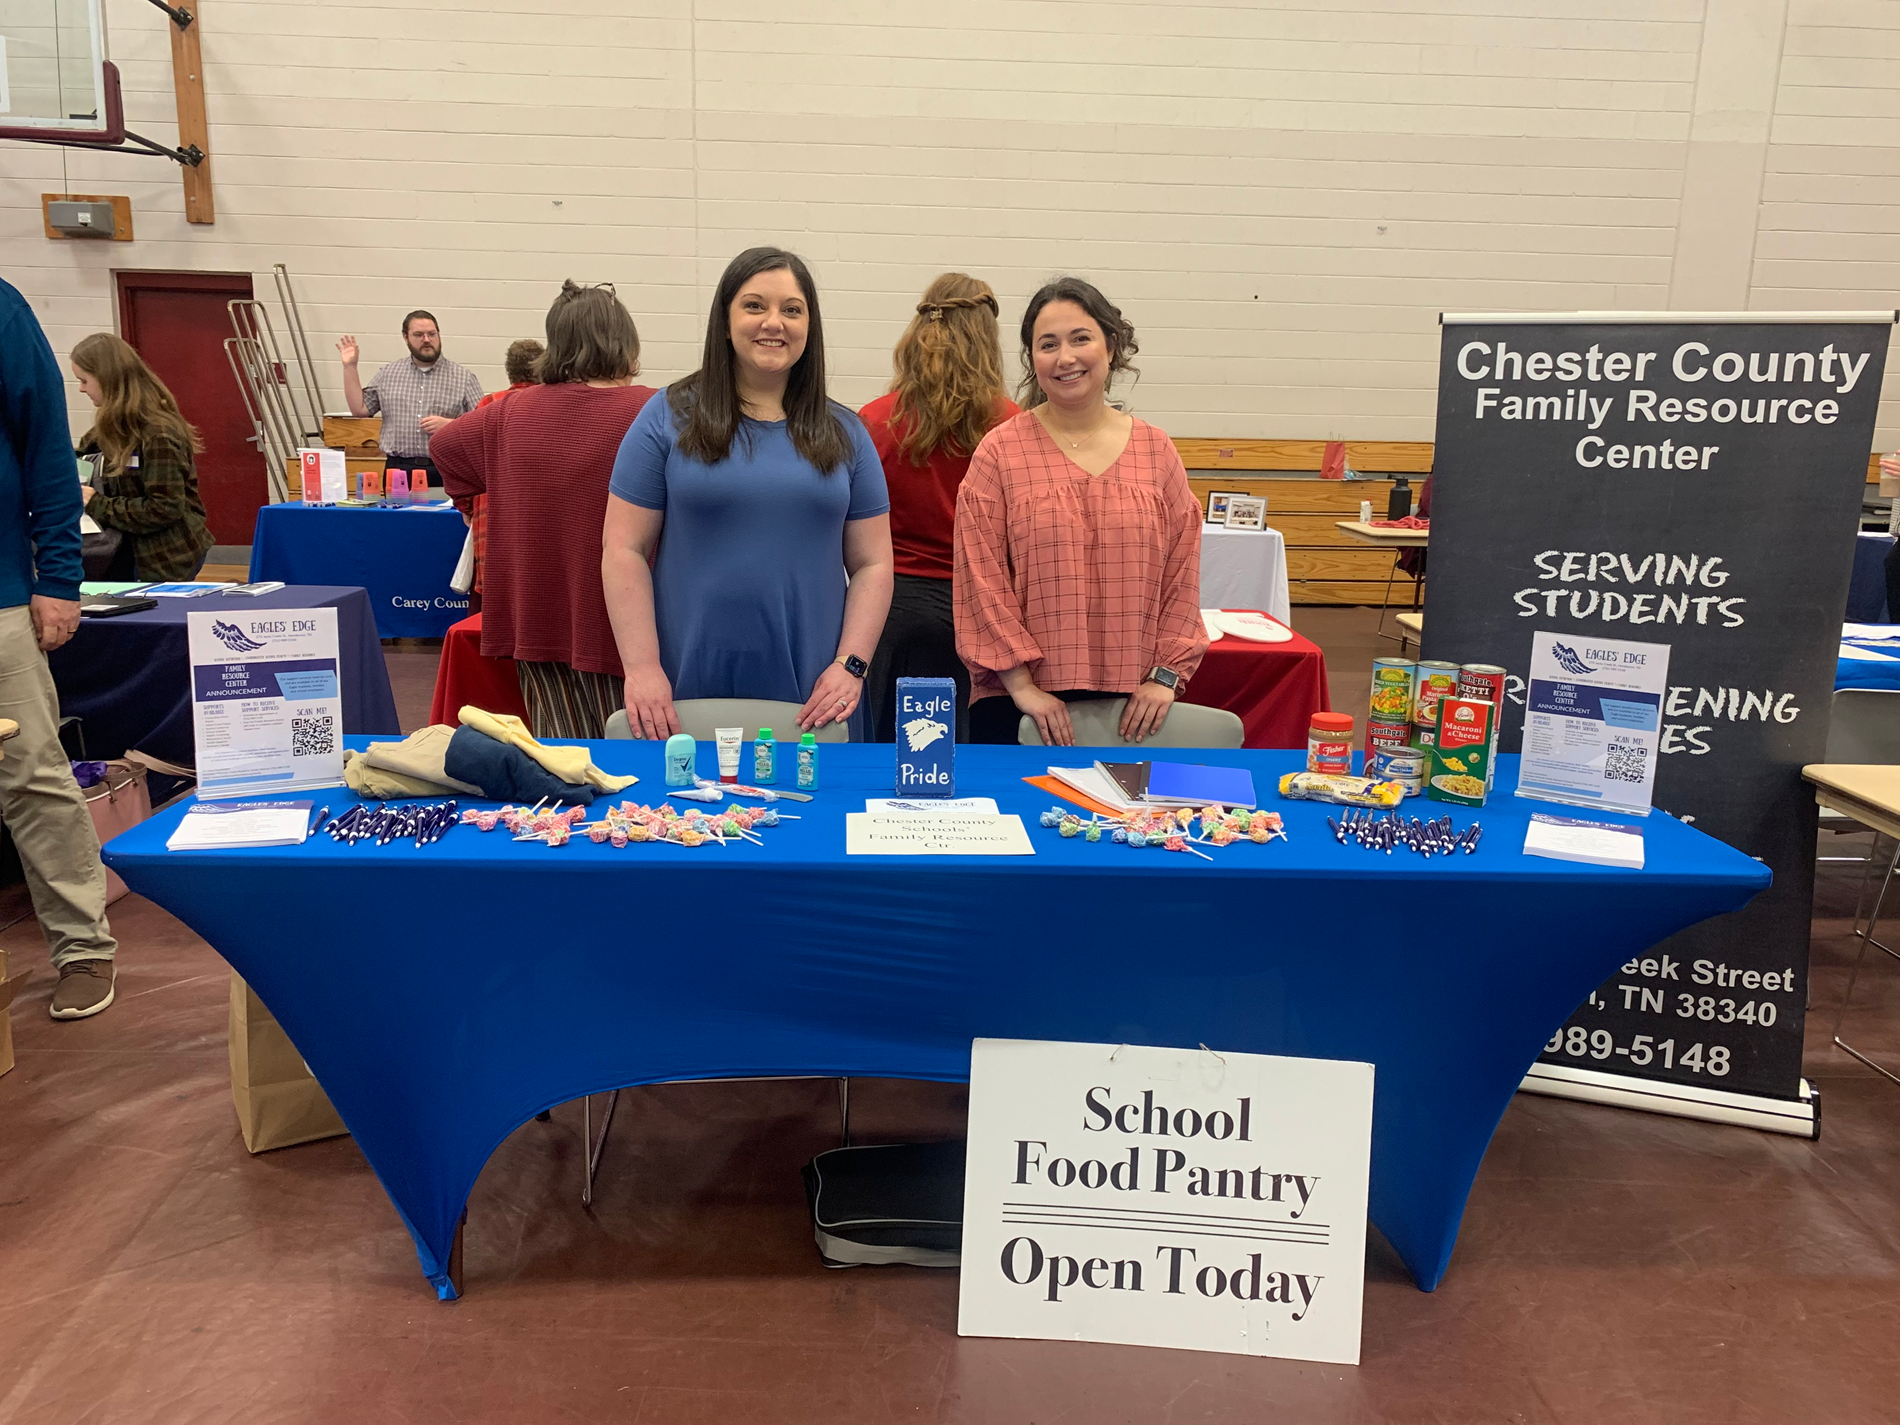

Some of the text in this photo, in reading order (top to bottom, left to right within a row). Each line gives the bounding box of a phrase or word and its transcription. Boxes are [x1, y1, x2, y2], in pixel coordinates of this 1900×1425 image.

[1457, 341, 1870, 393] Chester County
[1475, 388, 1839, 430] Family Resource
[1575, 435, 1719, 470] Center
[1533, 550, 1730, 588] SERVING
[391, 596, 469, 611] Carey Coun
[1513, 588, 1747, 628] STUDENTS
[251, 620, 316, 634] EAGLES' EDGE
[1585, 648, 1647, 666] EAGLES' EDGE
[222, 672, 250, 680] RESOURCE
[1460, 674, 1493, 686] outhgate
[226, 680, 247, 688] CENTER
[1556, 683, 1575, 692] FAMILY
[206, 687, 267, 697] ANNOUNCEMENT
[1553, 690, 1578, 699] RESOURCE
[903, 696, 951, 717] Eagle
[1555, 697, 1574, 705] CENTER
[297, 708, 313, 716] SCAN
[1537, 703, 1591, 715] ANNOUNCEMENT
[1371, 727, 1407, 737] Southgate
[1444, 722, 1482, 734] Macaroni
[1372, 737, 1401, 747] BEEF
[1614, 735, 1630, 743] SCAN
[1322, 745, 1345, 756] Fisher
[900, 763, 949, 785] Pride
[939, 818, 996, 826] County
[869, 834, 926, 842] Family
[1621, 955, 1795, 992] eek Street
[1618, 984, 1664, 1013] TN
[1676, 993, 1777, 1026] 38340
[1083, 1086, 1253, 1142] School
[1012, 1139, 1321, 1219] Food Pantry
[1000, 1236, 1325, 1322] Open Today
